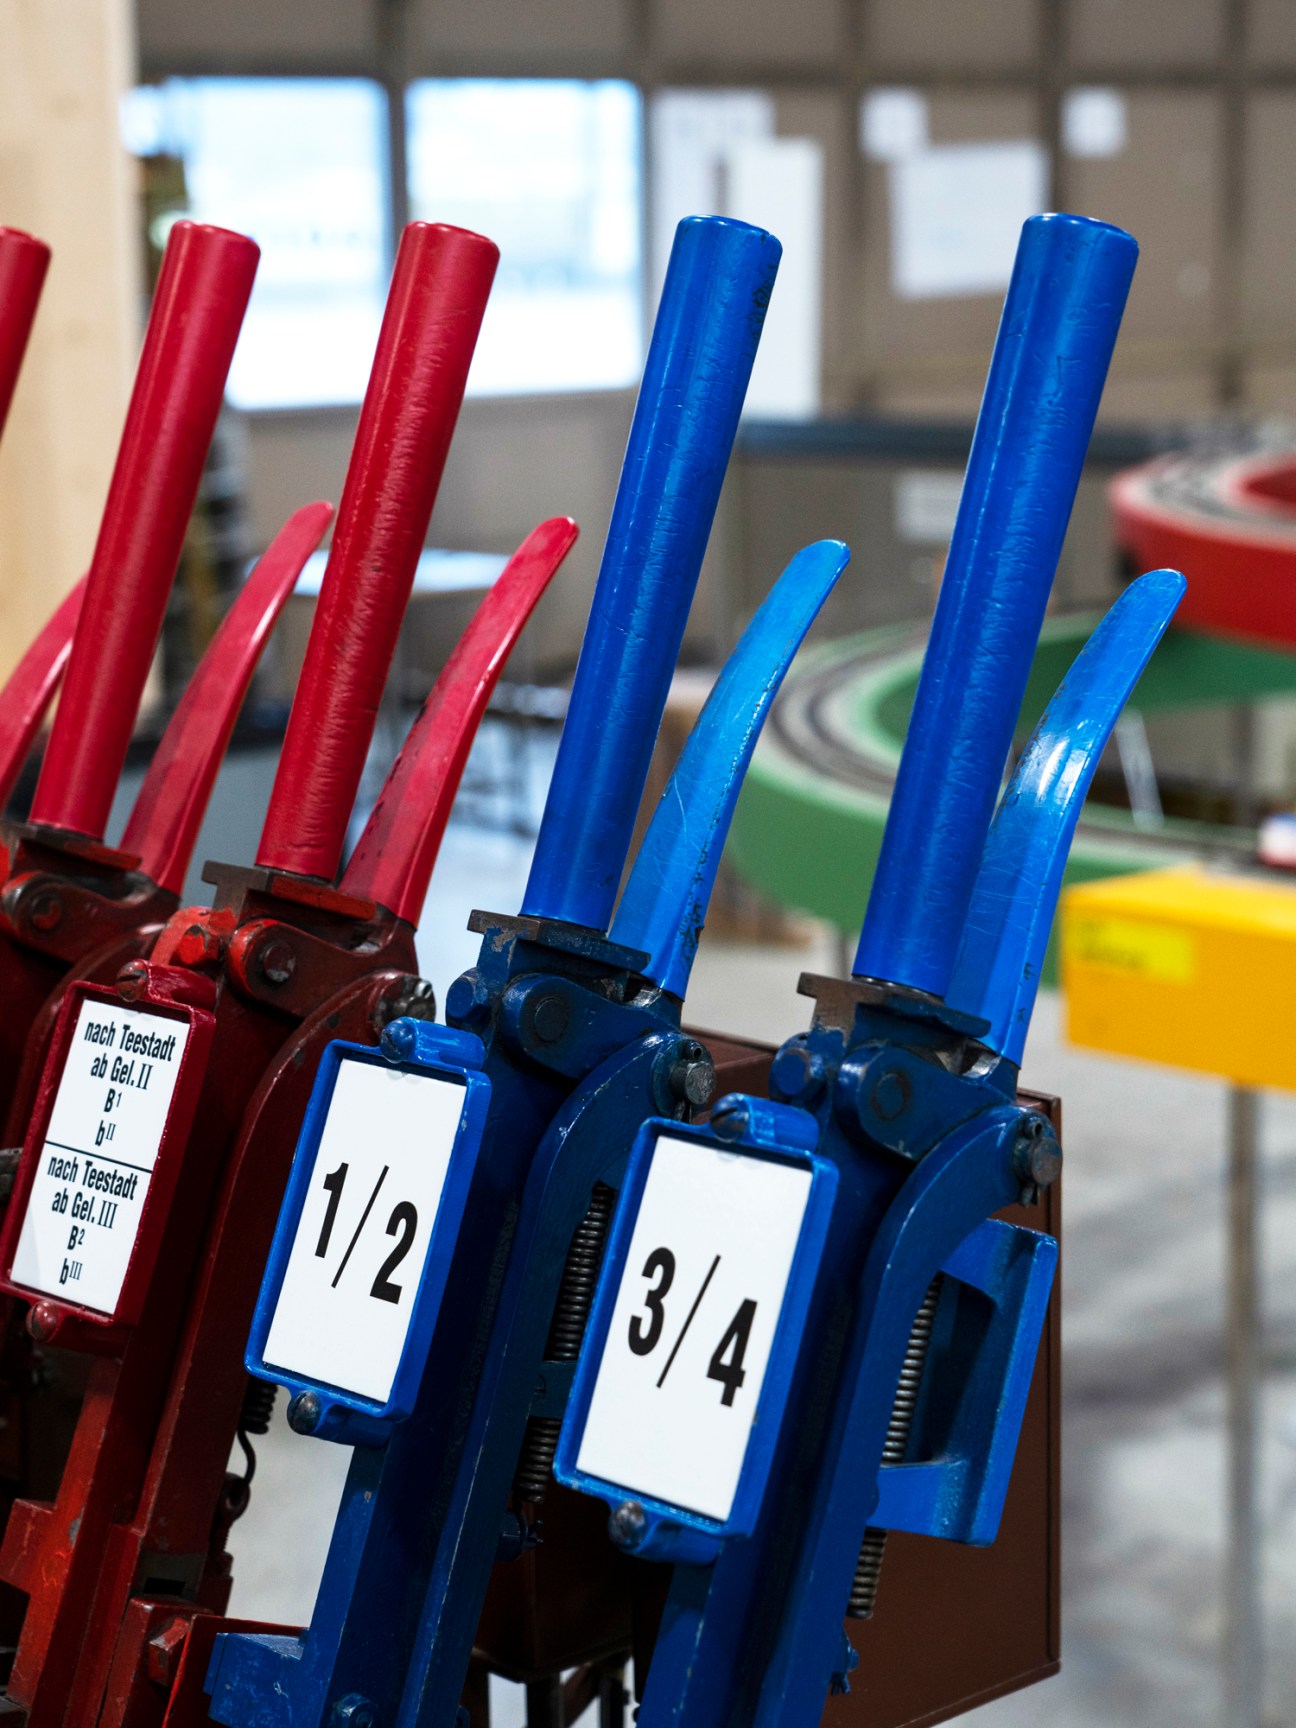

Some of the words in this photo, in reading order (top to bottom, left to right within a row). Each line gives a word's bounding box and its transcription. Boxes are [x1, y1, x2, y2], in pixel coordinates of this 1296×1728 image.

[84, 1021, 116, 1047] nach
[119, 1024, 176, 1062] Teestadt
[90, 1052, 108, 1079] ab
[47, 1156, 79, 1183] nach
[82, 1160, 138, 1201] Teestadt
[51, 1187, 69, 1215] ab
[314, 1162, 418, 1305] 1/2
[627, 1246, 758, 1408] 3/4
